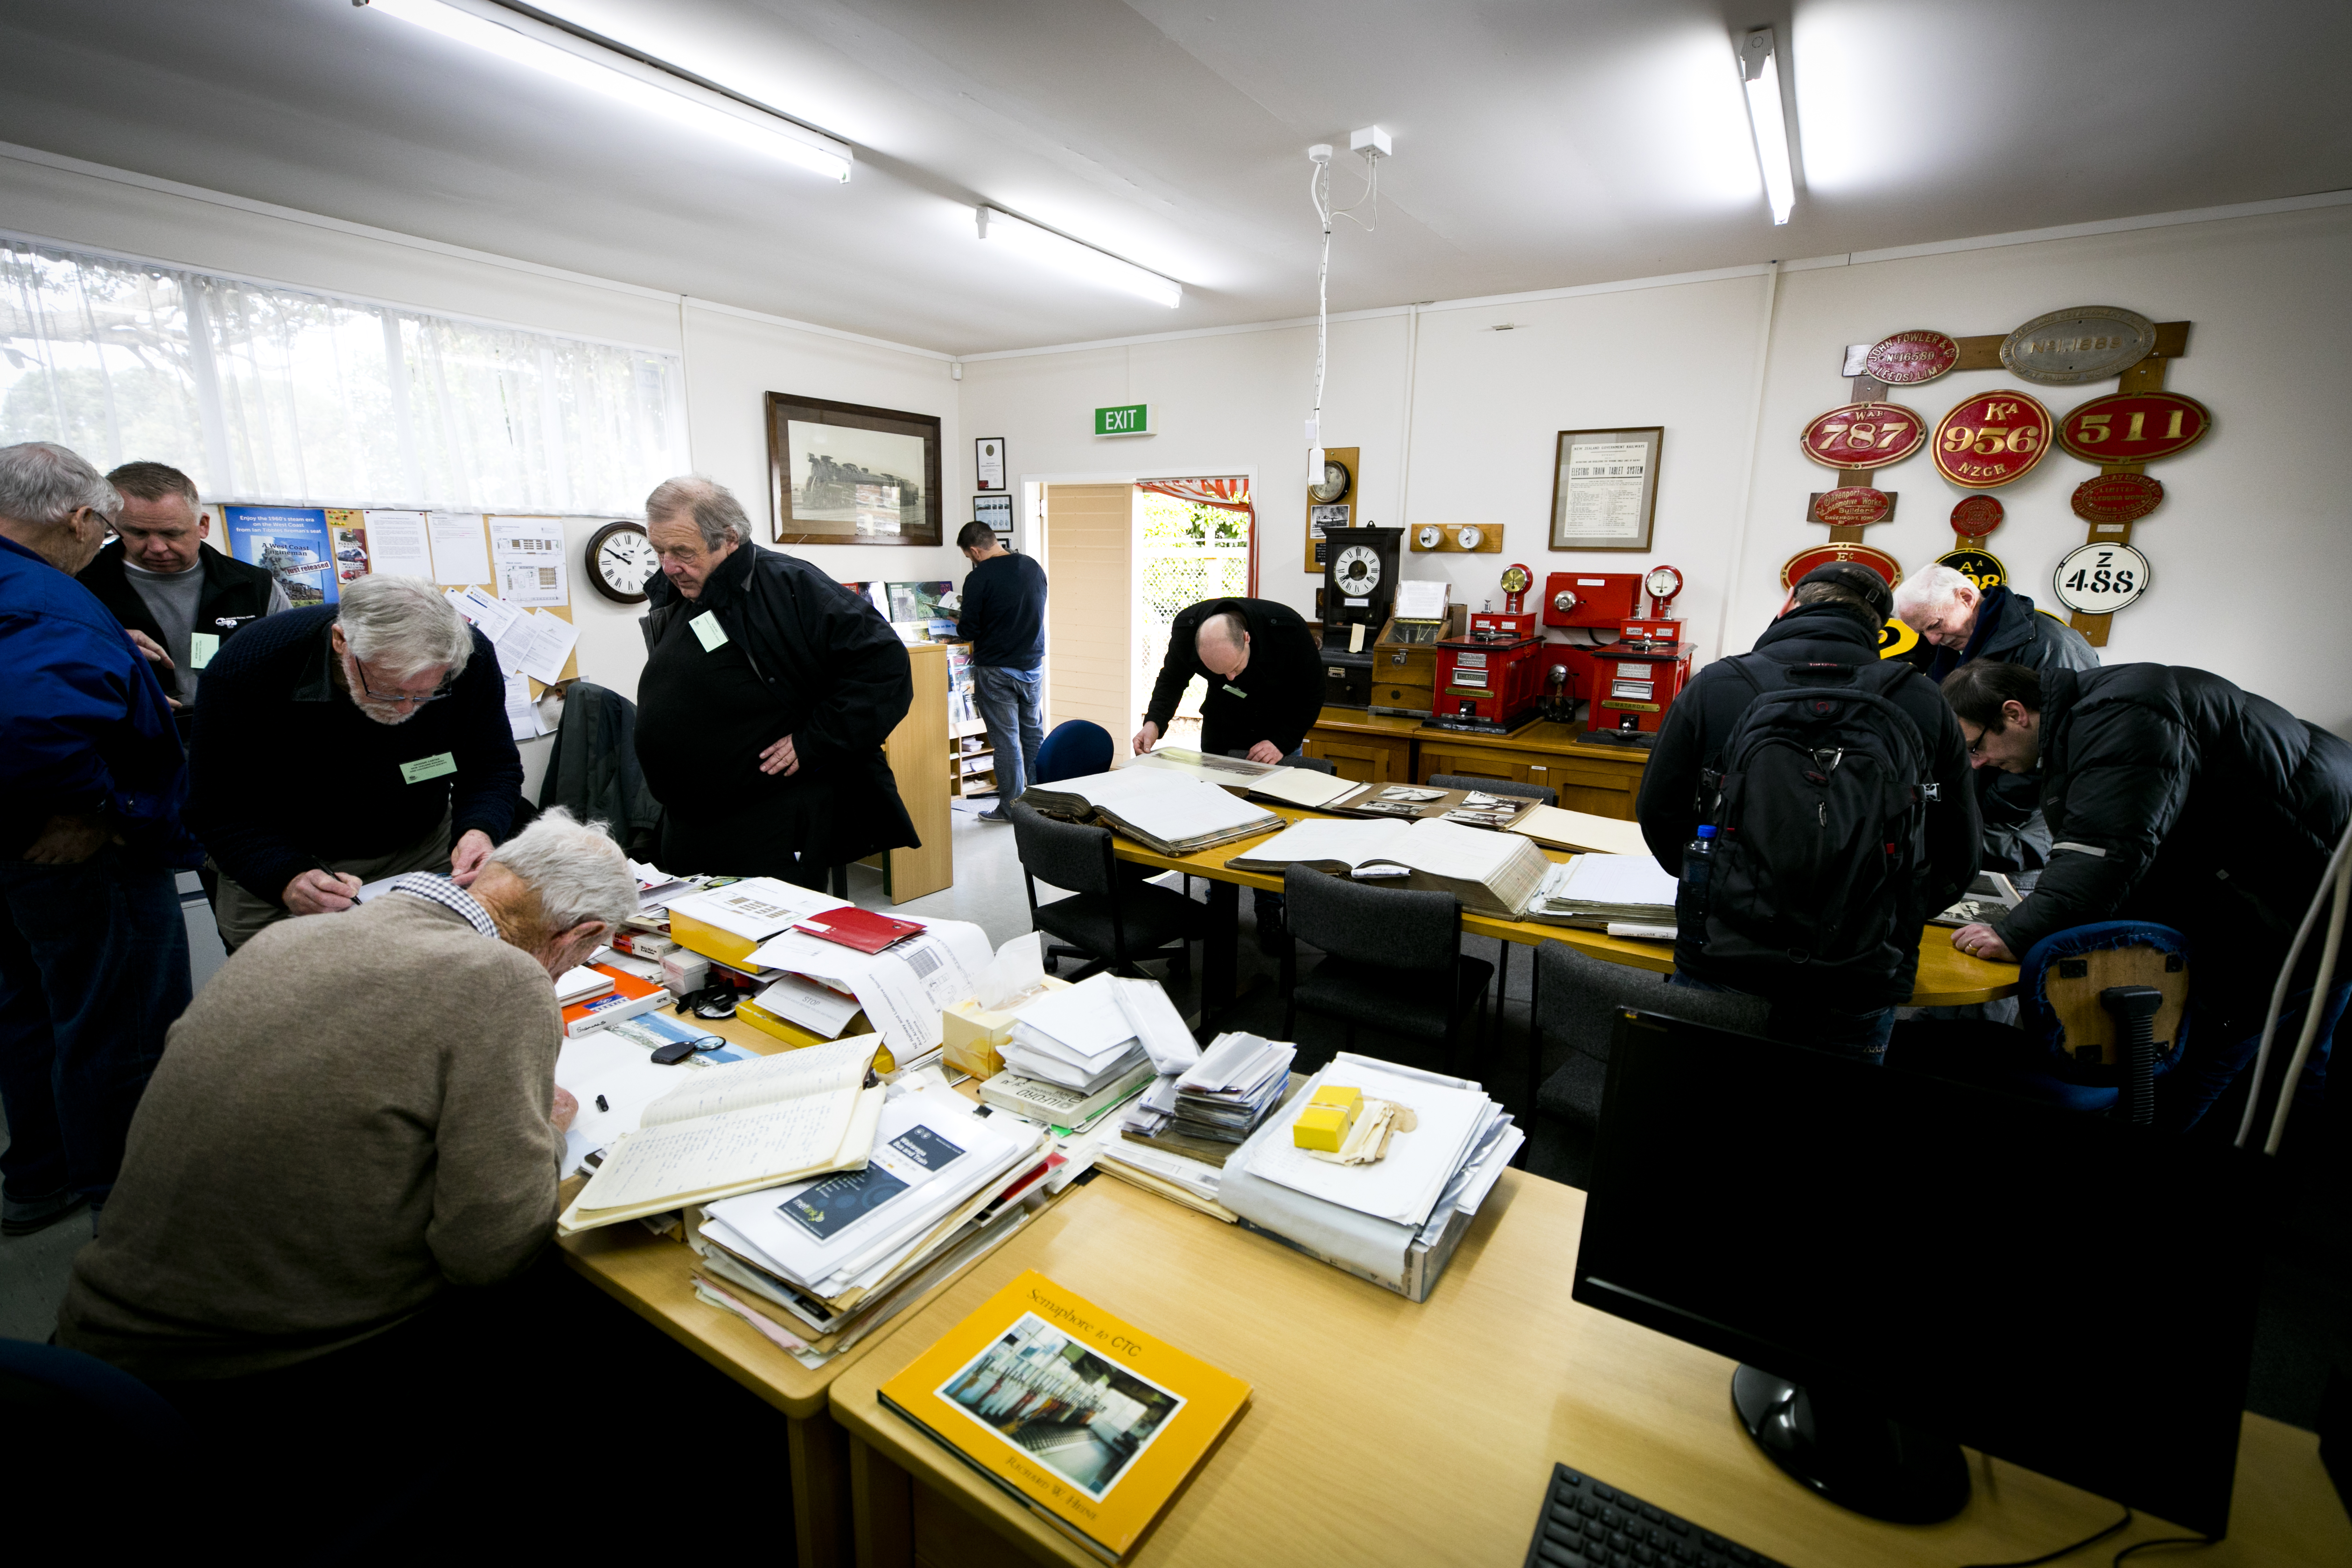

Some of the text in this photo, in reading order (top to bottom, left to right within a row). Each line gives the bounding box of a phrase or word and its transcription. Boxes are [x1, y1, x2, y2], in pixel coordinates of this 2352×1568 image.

[2014, 315, 2056, 338] ZEALAND
[2059, 309, 2125, 319] GOVERNMENT
[1868, 339, 1893, 363] JOHN
[1897, 333, 1940, 344] FOWLER
[1939, 340, 1948, 349] &
[1875, 366, 1913, 382] (LEEDS)
[2007, 359, 2026, 374] BUILT
[2028, 371, 2037, 380] AT
[1106, 409, 1136, 430] EXIT
[2077, 409, 2187, 444] 511
[1817, 422, 1909, 450] 787
[1944, 425, 2040, 455] 956
[1571, 468, 1589, 476] ELECTRIC
[1593, 467, 1605, 475] TRAIN
[1627, 466, 1643, 474] SYSTEM
[1958, 462, 2007, 478] NZGR
[1824, 490, 1860, 506] Davenport
[1862, 497, 1882, 505] Works
[2120, 497, 2161, 520] SCOTLAND
[286, 561, 329, 574] Just released
[2096, 552, 2113, 567] Z
[2065, 569, 2134, 594] 488
[868, 974, 881, 989] Society
[802, 996, 820, 1006] STOP
[880, 989, 897, 1015] Locomotive
[576, 1021, 606, 1033] SIGNALS
[902, 1024, 914, 1042] Railway
[905, 1019, 916, 1036] Archive
[913, 1021, 927, 1043] Locations
[1016, 1090, 1062, 1106] ILFORD
[1028, 1085, 1068, 1101] PHOTOGRAPHIC
[893, 1141, 928, 1166] Bus and Train
[900, 1136, 927, 1157] Wairarapa
[1026, 1287, 1142, 1358] Semaphore to CTC
[1051, 1485, 1066, 1502] W.
